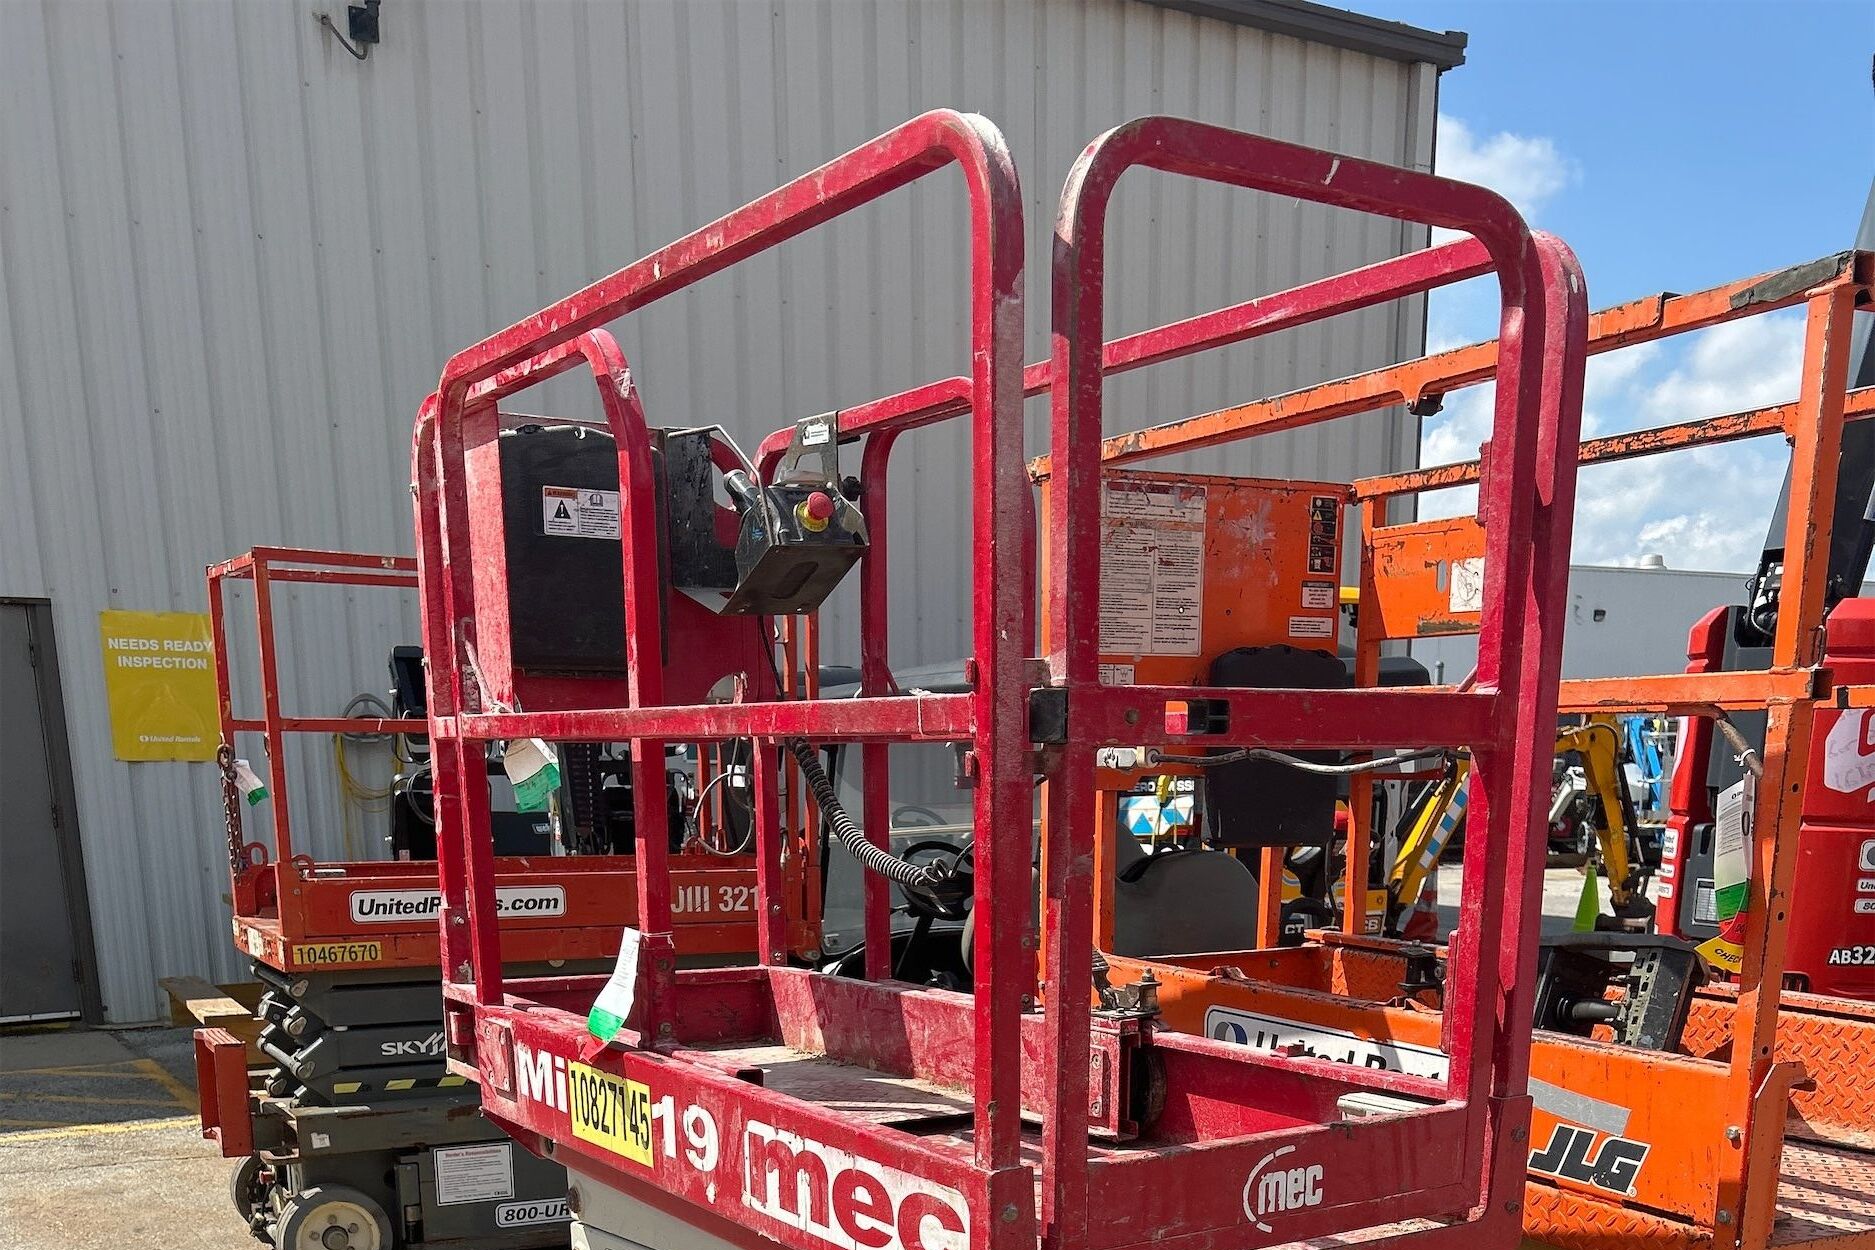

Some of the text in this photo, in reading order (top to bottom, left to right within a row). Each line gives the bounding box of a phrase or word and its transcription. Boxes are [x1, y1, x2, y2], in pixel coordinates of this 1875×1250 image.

[108, 638, 213, 652] NEEDS READY
[118, 656, 207, 669] INSPECTION
[358, 895, 559, 916] UnitedRs.com
[297, 944, 378, 965] 10467670
[1828, 946, 1875, 965] AB32
[571, 1070, 650, 1151] 10827145
[652, 1094, 719, 1172] 19
[1528, 1124, 1649, 1194] JLG
[1257, 1164, 1323, 1215] mec
